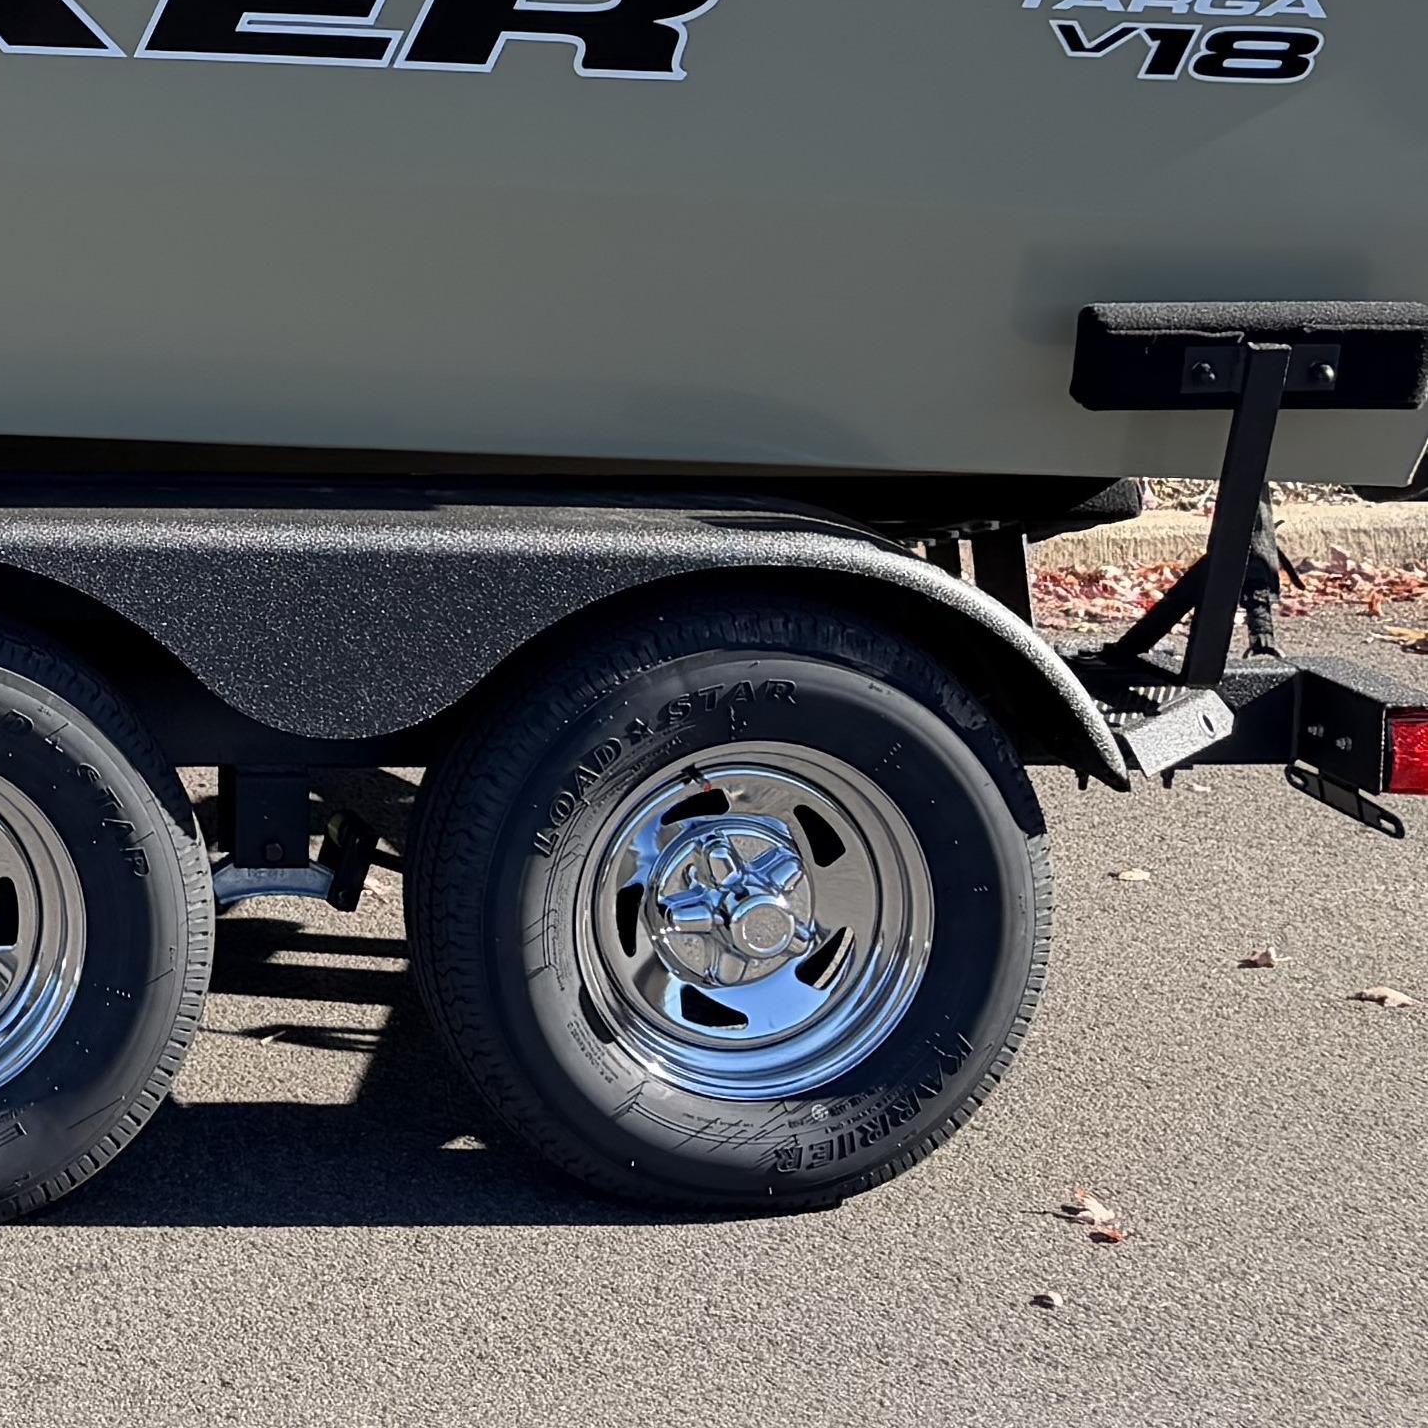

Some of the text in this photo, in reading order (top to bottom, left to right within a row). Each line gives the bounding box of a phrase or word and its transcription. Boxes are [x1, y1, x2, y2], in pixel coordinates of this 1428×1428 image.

[1049, 19, 1325, 83] V18
[534, 737, 623, 858] LOAD
[656, 679, 798, 725] STAR
[774, 1032, 974, 1174] KARRIER
